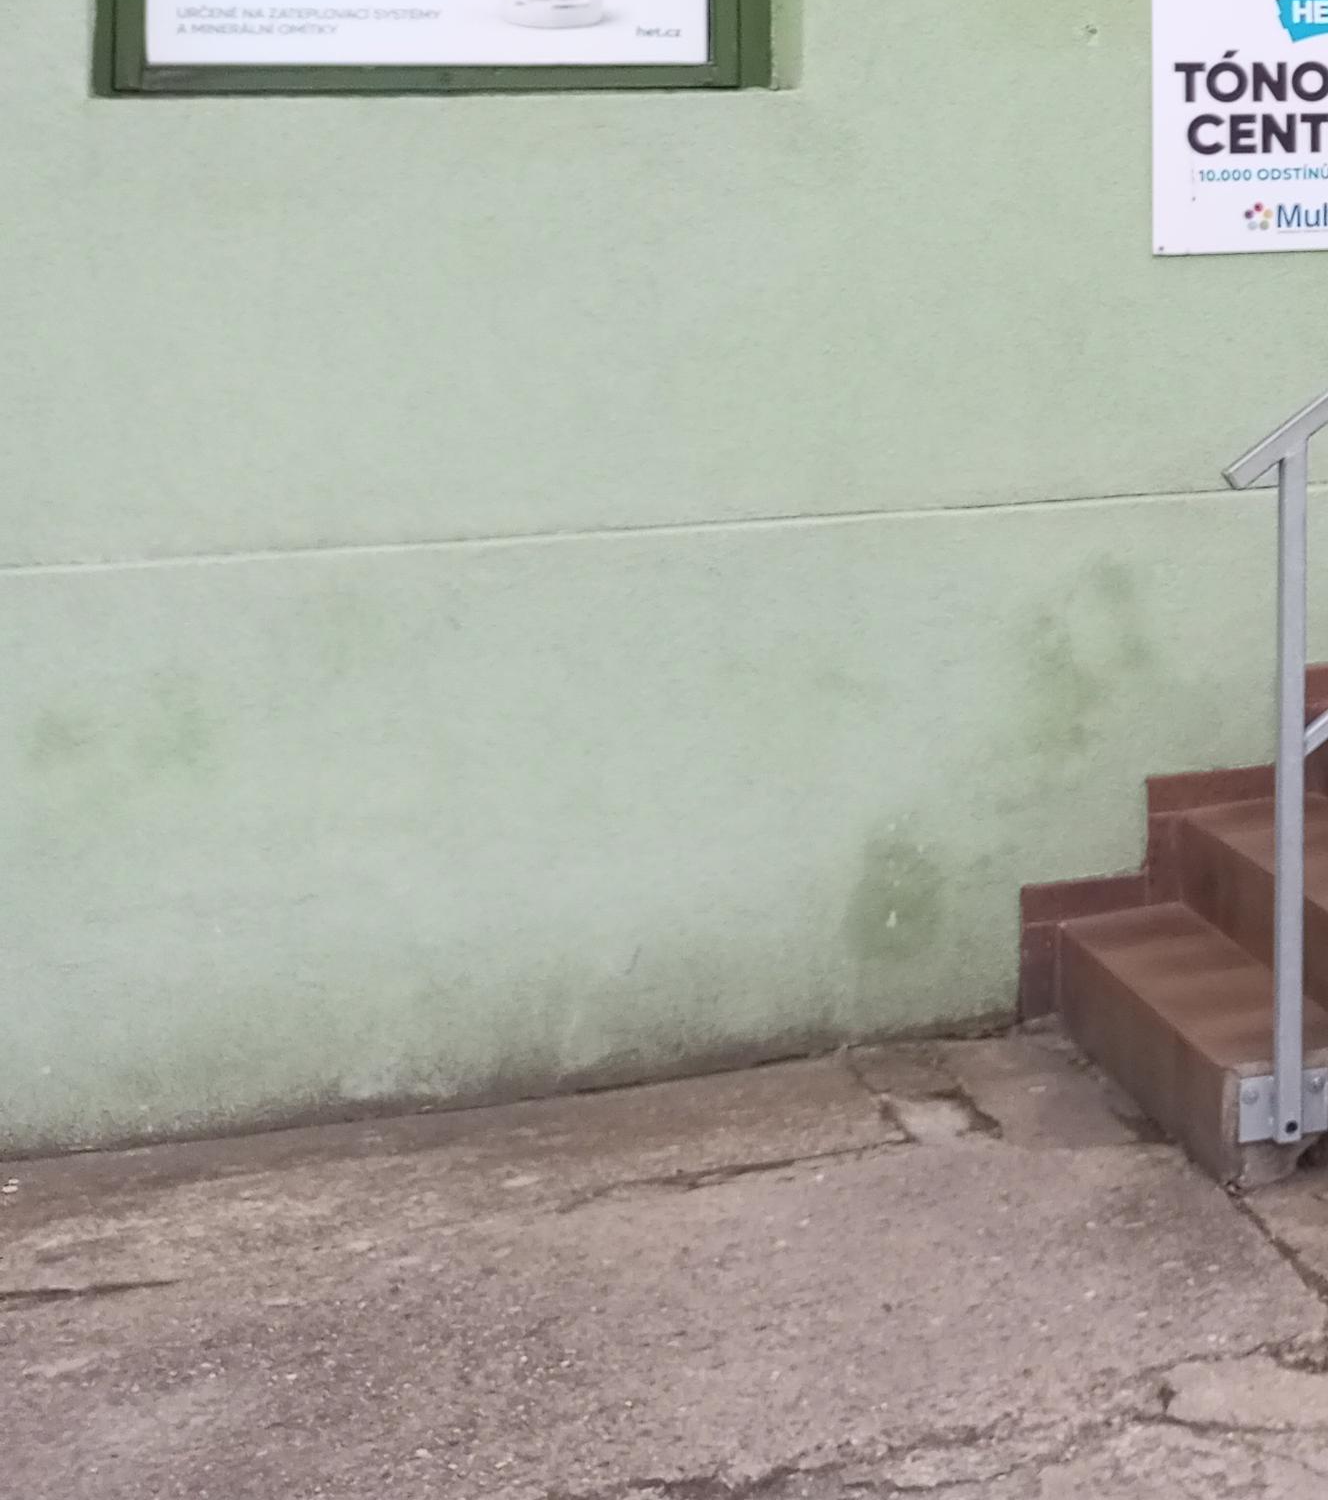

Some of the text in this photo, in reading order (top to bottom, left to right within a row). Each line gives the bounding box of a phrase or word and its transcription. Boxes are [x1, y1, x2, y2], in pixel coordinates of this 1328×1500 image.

[242, 7, 264, 20] NA
[635, 26, 682, 39] het.cz
[1199, 169, 1252, 182] 10.000
